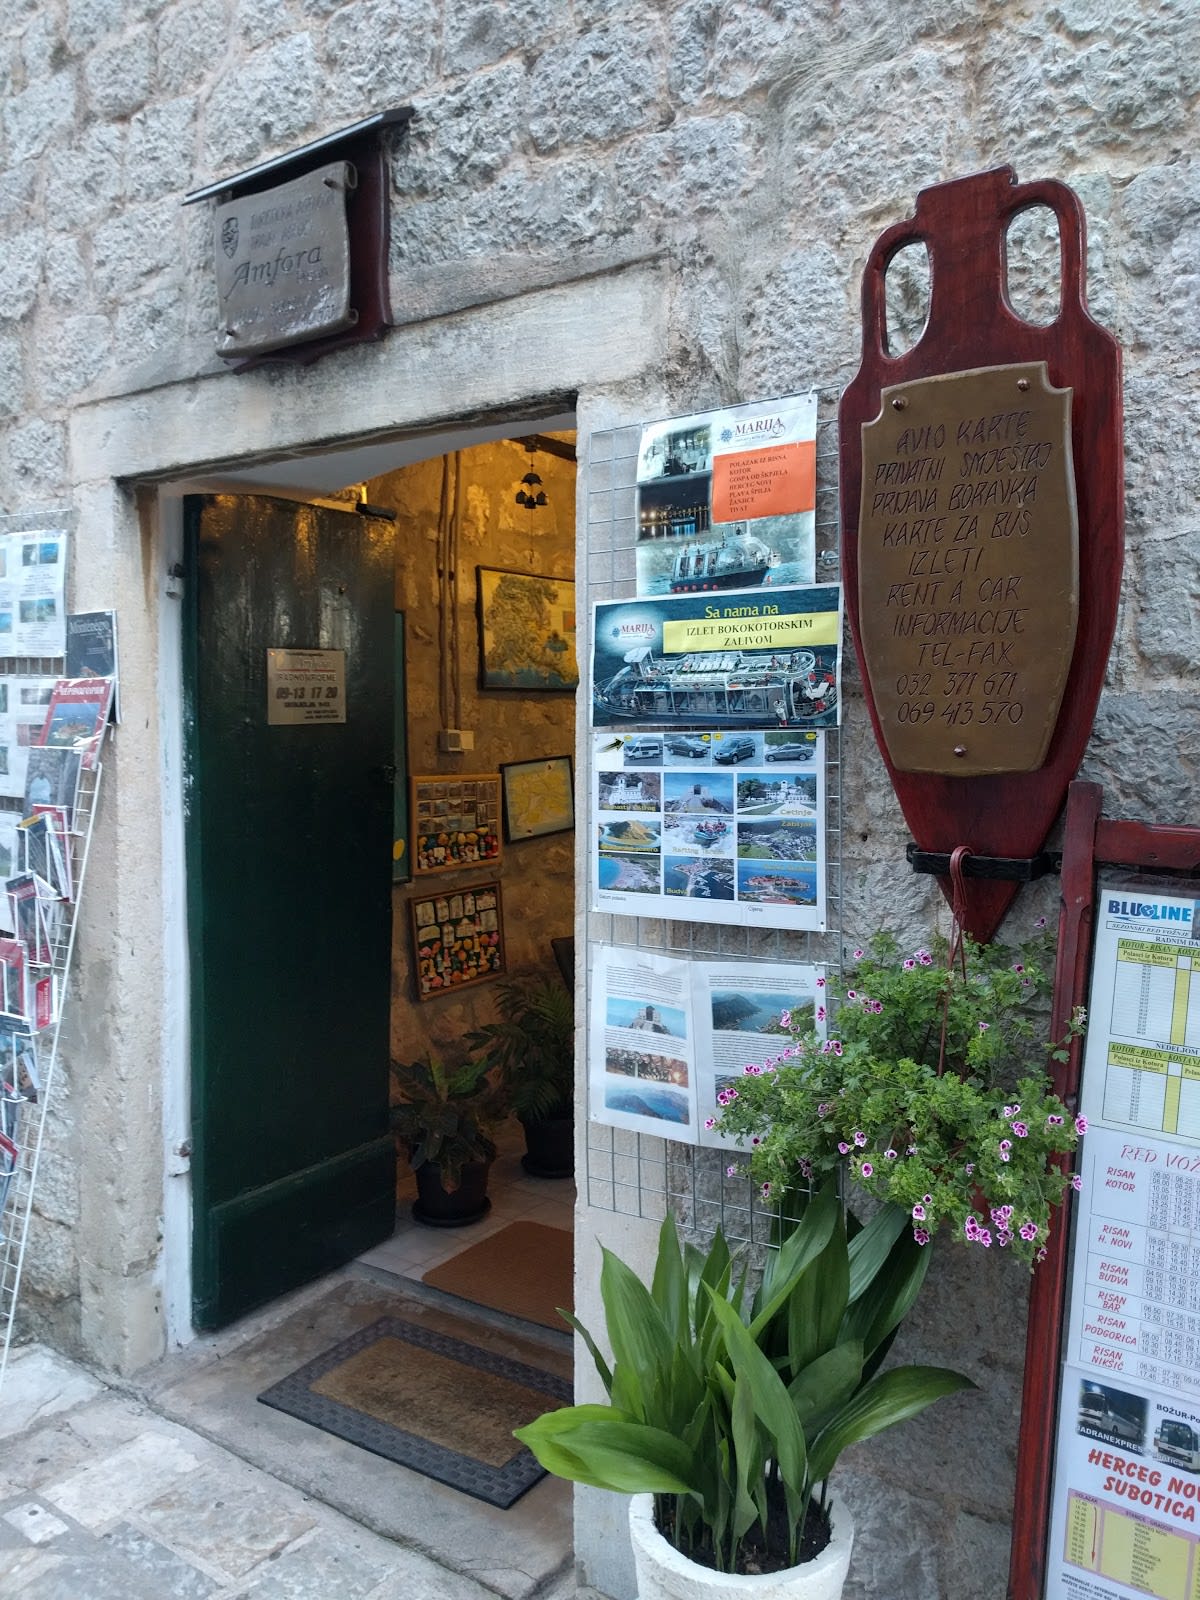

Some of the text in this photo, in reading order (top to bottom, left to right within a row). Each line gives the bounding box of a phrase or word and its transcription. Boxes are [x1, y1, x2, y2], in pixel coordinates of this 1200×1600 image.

[223, 246, 321, 302] Amfora
[735, 417, 782, 436] MARIJA
[896, 411, 1032, 455] AVIO KARTE
[729, 467, 751, 475] KOTOR
[875, 457, 945, 487] PRIVATNI
[872, 476, 1039, 517] PRIJAVA BORAVKA
[883, 510, 1033, 547] KARTE ZA BUS
[909, 547, 984, 577] IZLETI
[887, 576, 1023, 608] RENT A CAR
[705, 604, 779, 619] Sa nama na
[621, 624, 653, 634] MARIJA
[686, 619, 813, 637] IZLET BOKOKOTORSKIM
[894, 608, 1030, 637] INFORMACIJE
[724, 635, 773, 647] ZALIVOM
[918, 641, 1016, 667] TEL-FAX
[896, 672, 1018, 697] 032 371 671
[898, 701, 1024, 725] 069 413 570
[667, 887, 688, 895] Budva
[1111, 923, 1146, 932] SEZONSKI
[1162, 928, 1189, 937] VOŽNJE
[1121, 941, 1173, 953] KOTOR RISAN
[1155, 936, 1187, 945] RADNIM
[1111, 1044, 1163, 1058] KOTOR RISAN
[1156, 1043, 1199, 1055] NEDELJOM
[1120, 1144, 1157, 1163] RED
[1106, 1166, 1136, 1180] RISAN
[1105, 1178, 1136, 1192] KOTOR
[1102, 1224, 1130, 1238] RISAN
[1098, 1235, 1133, 1250] H. NOVI
[1100, 1262, 1129, 1276] RISAN
[1098, 1272, 1128, 1286] BUDVA
[1097, 1291, 1127, 1305] RISAN
[1102, 1300, 1121, 1313] BAR
[1097, 1314, 1127, 1329] RISAN
[1084, 1324, 1137, 1346] PODGORICA
[1093, 1346, 1123, 1360] RISAN
[1091, 1355, 1124, 1371] NIKŠIĆ
[1088, 1448, 1162, 1486] HERCEG
[1103, 1476, 1195, 1522] SUBOTICA
